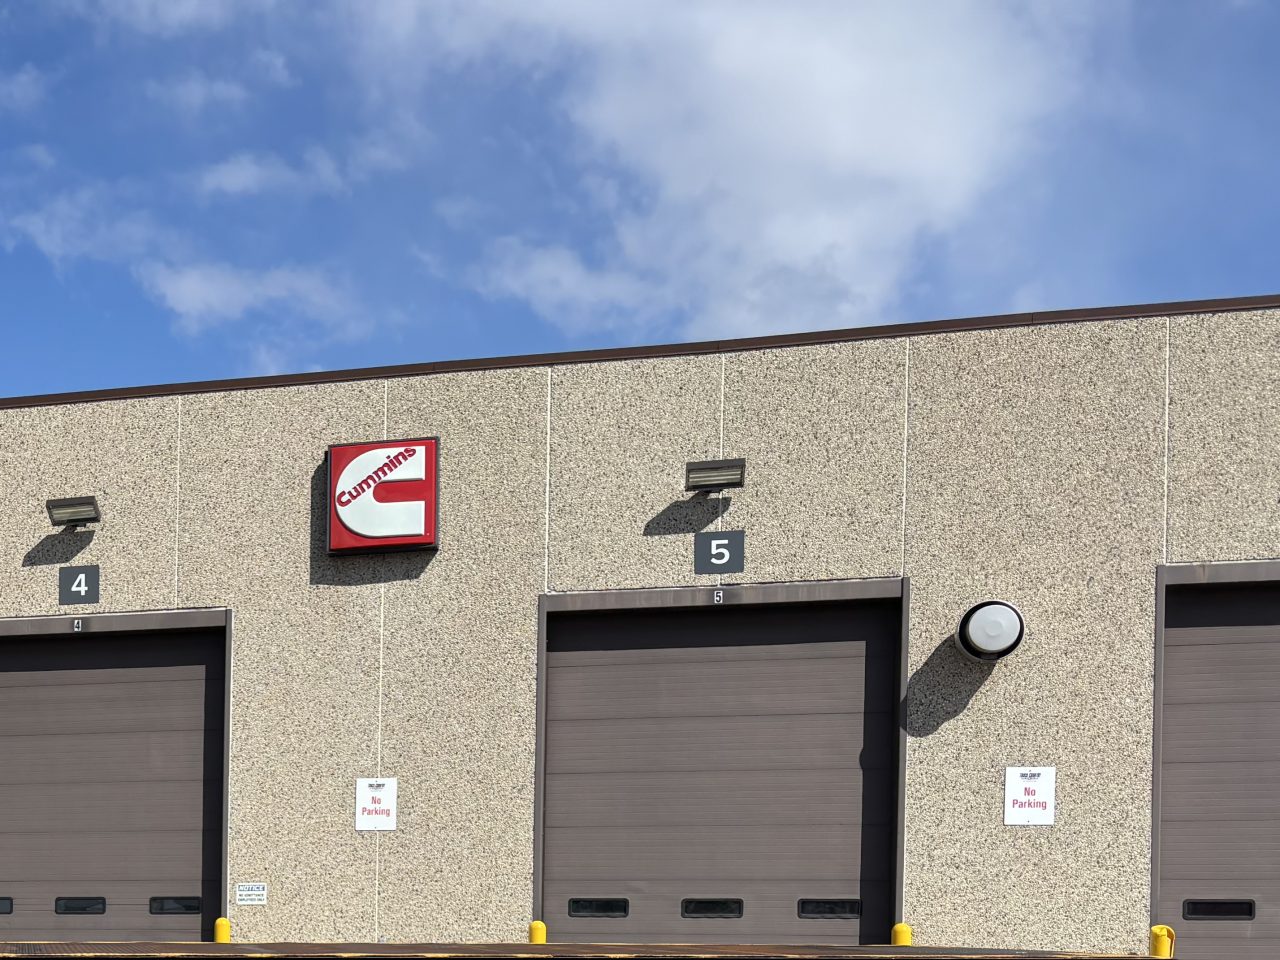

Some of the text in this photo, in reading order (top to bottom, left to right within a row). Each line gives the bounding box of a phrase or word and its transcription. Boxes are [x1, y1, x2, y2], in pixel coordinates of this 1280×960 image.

[336, 447, 417, 508] Cummins
[710, 539, 730, 565] 5
[71, 573, 89, 596] 4
[715, 591, 722, 603] 5
[1024, 787, 1036, 796] No
[371, 796, 381, 804] No
[1012, 799, 1047, 810] Parking
[361, 807, 390, 817] Parking
